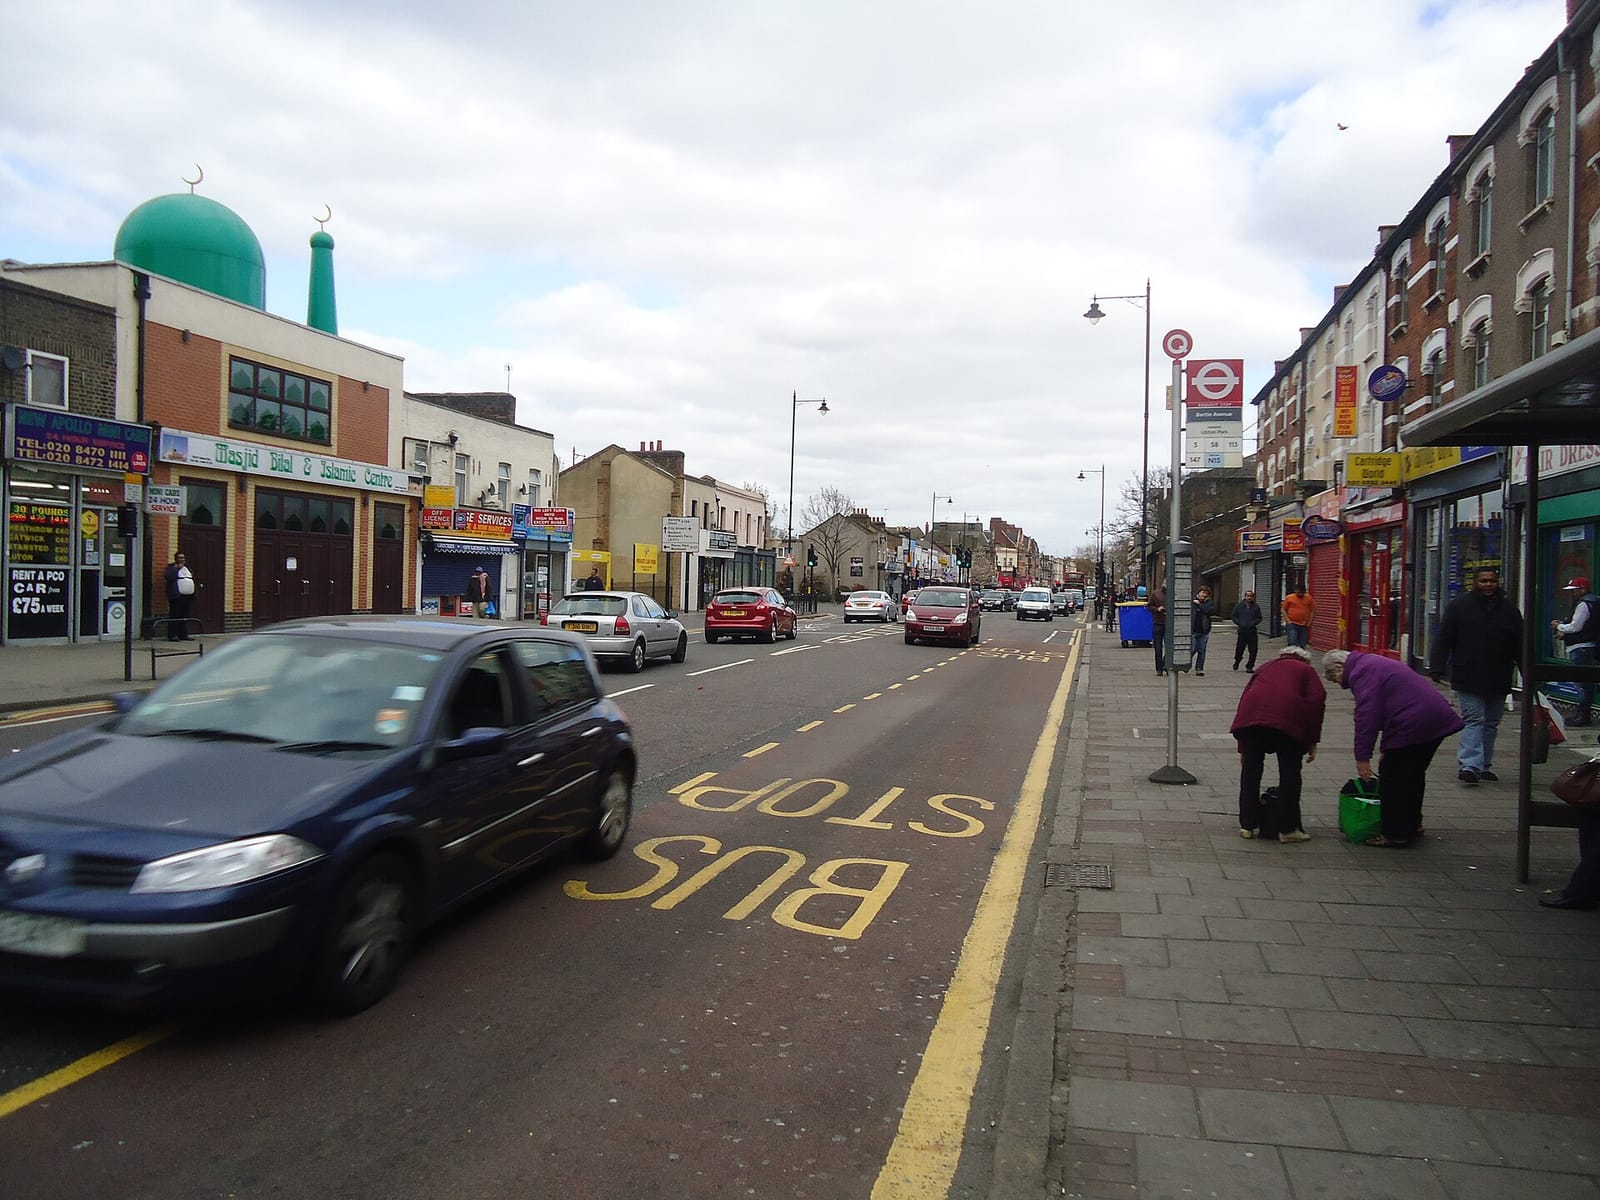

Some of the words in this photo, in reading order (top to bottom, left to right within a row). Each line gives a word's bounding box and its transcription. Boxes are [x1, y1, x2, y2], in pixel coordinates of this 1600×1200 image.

[18, 410, 46, 428] NEW
[51, 415, 92, 434] APOLLO
[16, 436, 71, 453] TEL:020
[75, 445, 105, 462] 8470
[110, 450, 127, 465] 1111
[16, 447, 71, 463] TEL:020
[75, 455, 105, 468] 8472
[108, 460, 129, 470] 1414
[1355, 456, 1393, 468] Cartridge
[215, 443, 259, 471] Masjid
[270, 451, 293, 474] Bilal
[304, 457, 312, 476] &
[320, 460, 357, 483] Islamic
[364, 467, 393, 488] Centre
[1361, 468, 1384, 478] World
[148, 487, 163, 495] MINI
[164, 488, 181, 497] CABS
[148, 496, 158, 504] 24
[160, 497, 180, 505] HOUR
[13, 504, 27, 513] 30
[31, 506, 70, 517] POUNDS
[151, 504, 177, 513] SERVICE
[478, 513, 512, 527] SERVICES
[12, 569, 36, 580] RENT
[38, 570, 45, 580] A
[46, 571, 65, 581] PCO
[13, 582, 47, 594] CAR
[12, 597, 41, 614] £75
[40, 604, 46, 613] A
[46, 604, 65, 613] WEEK
[667, 771, 995, 839] STOP
[563, 834, 909, 940] BUS
